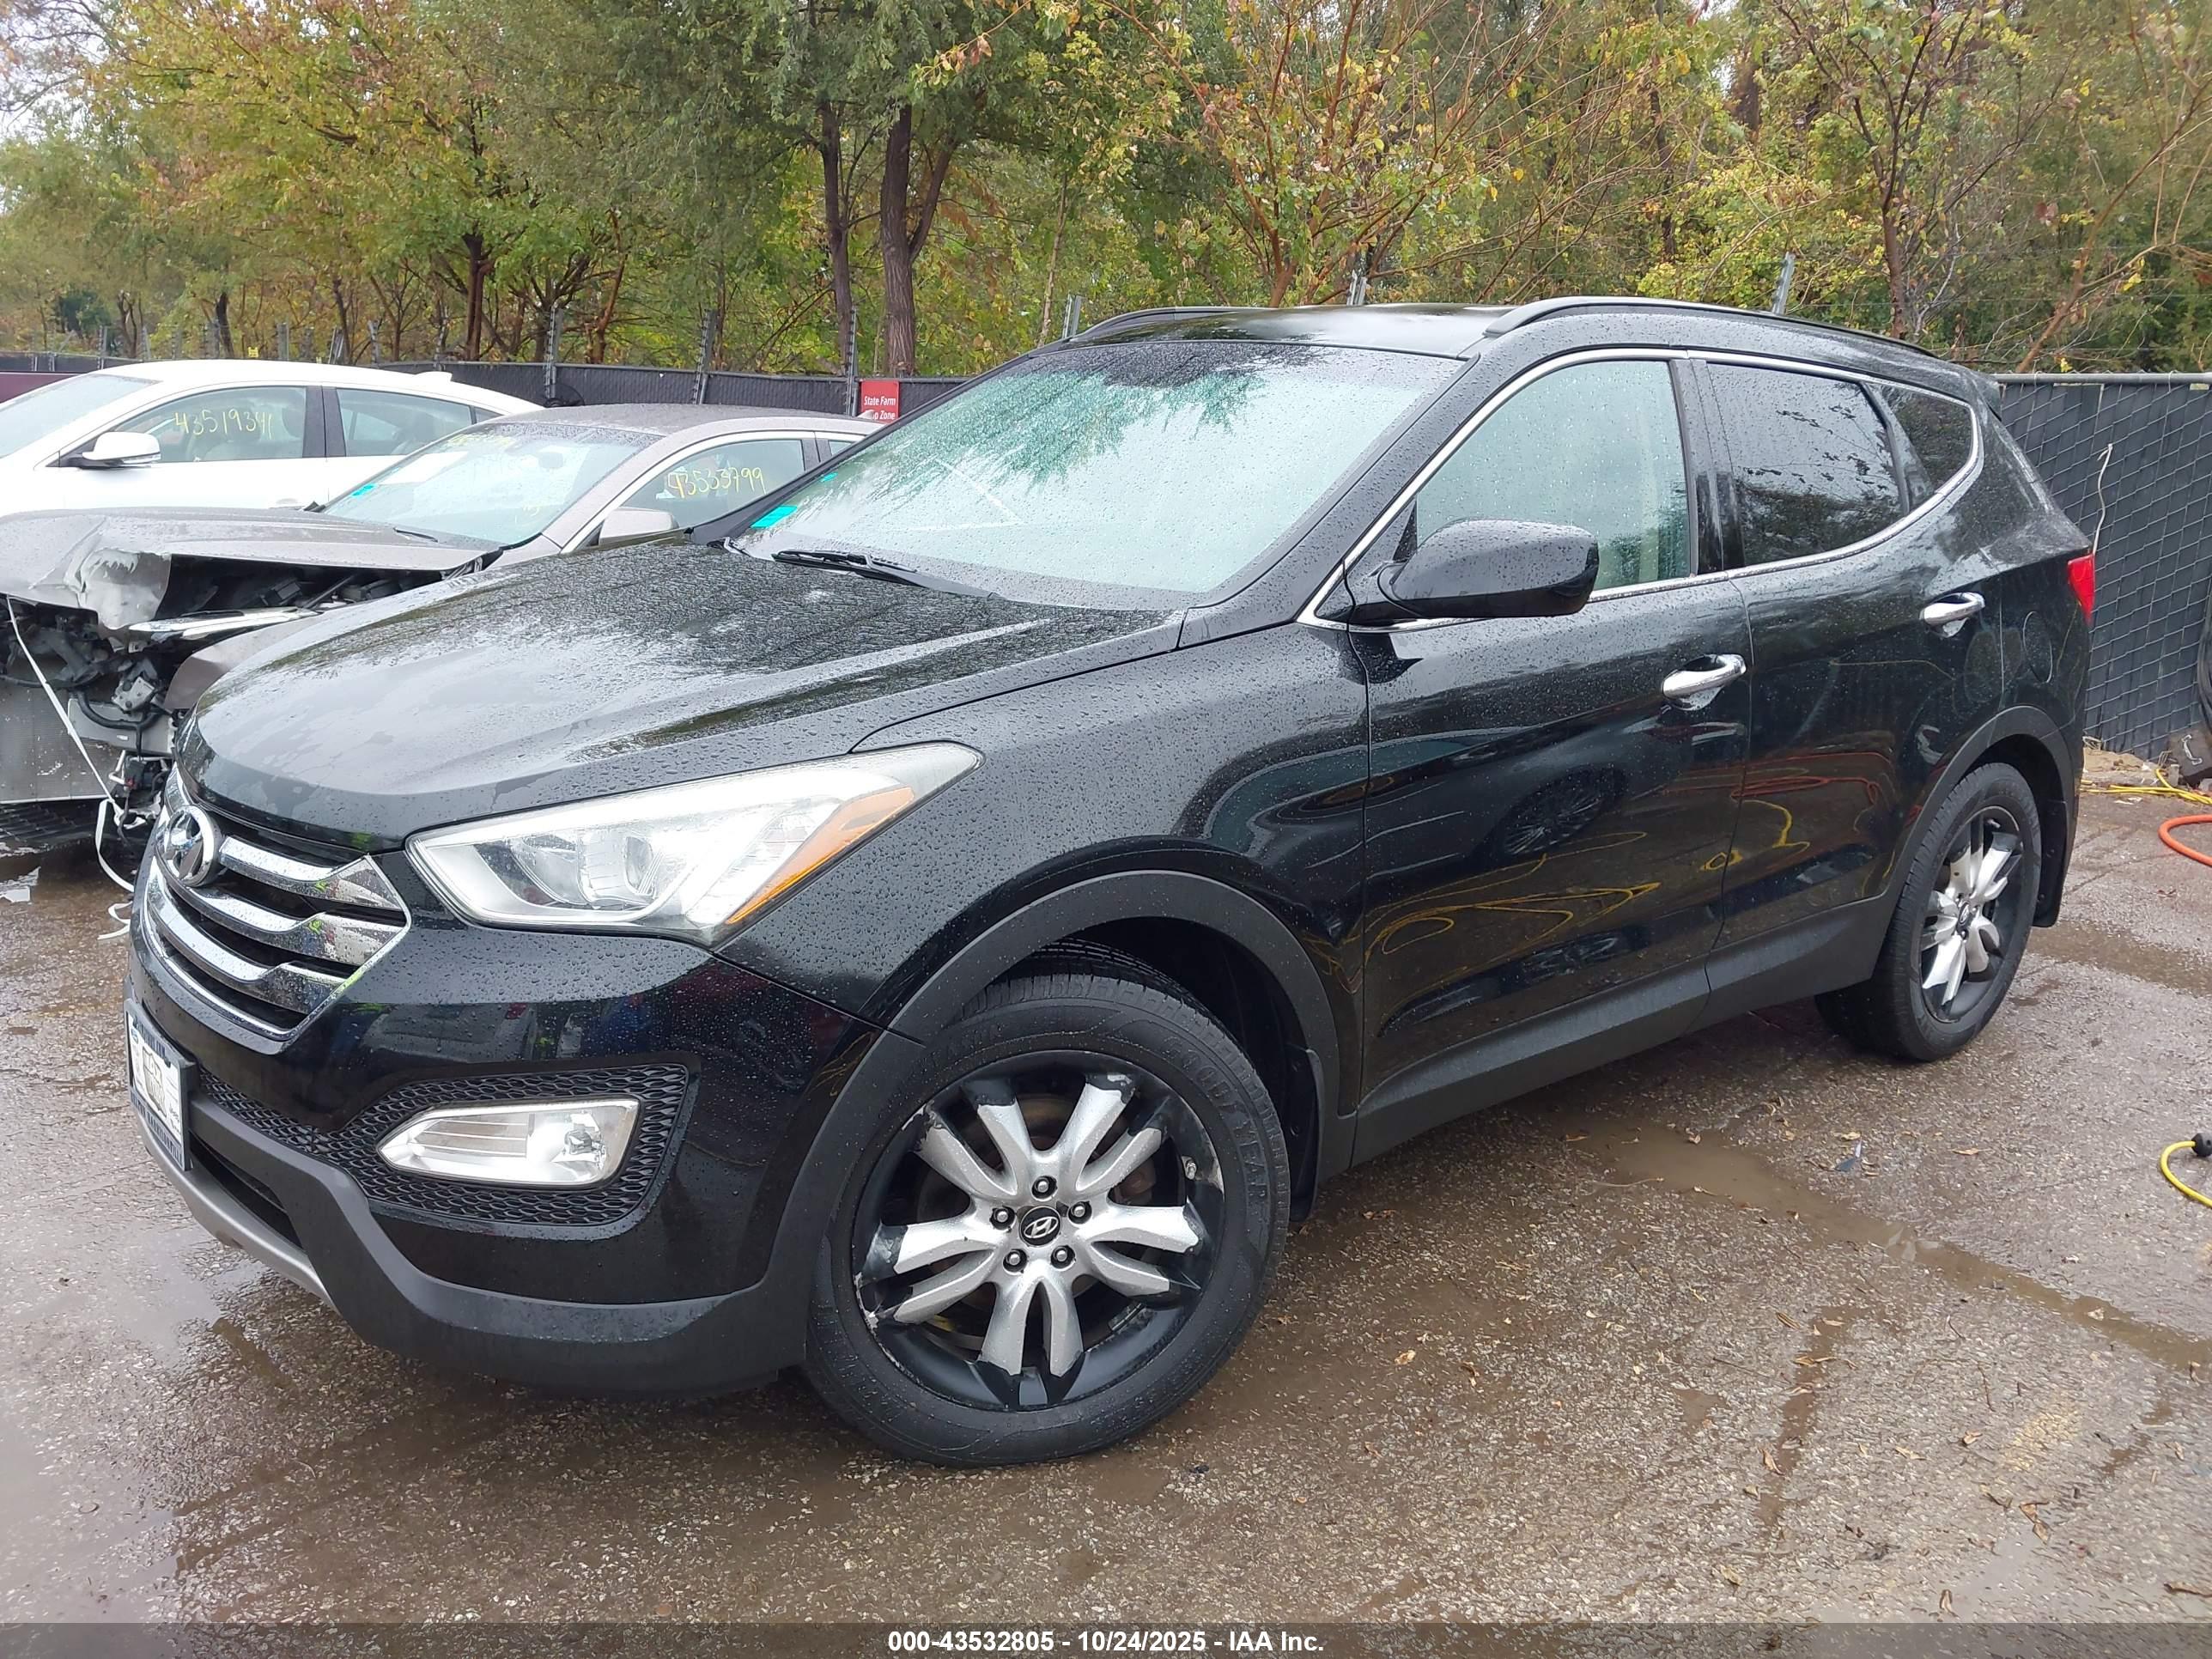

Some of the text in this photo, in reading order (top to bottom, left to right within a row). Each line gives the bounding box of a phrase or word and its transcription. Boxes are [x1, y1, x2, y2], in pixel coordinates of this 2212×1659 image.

[864, 395, 896, 405] State Farm
[879, 410, 896, 420] Zone
